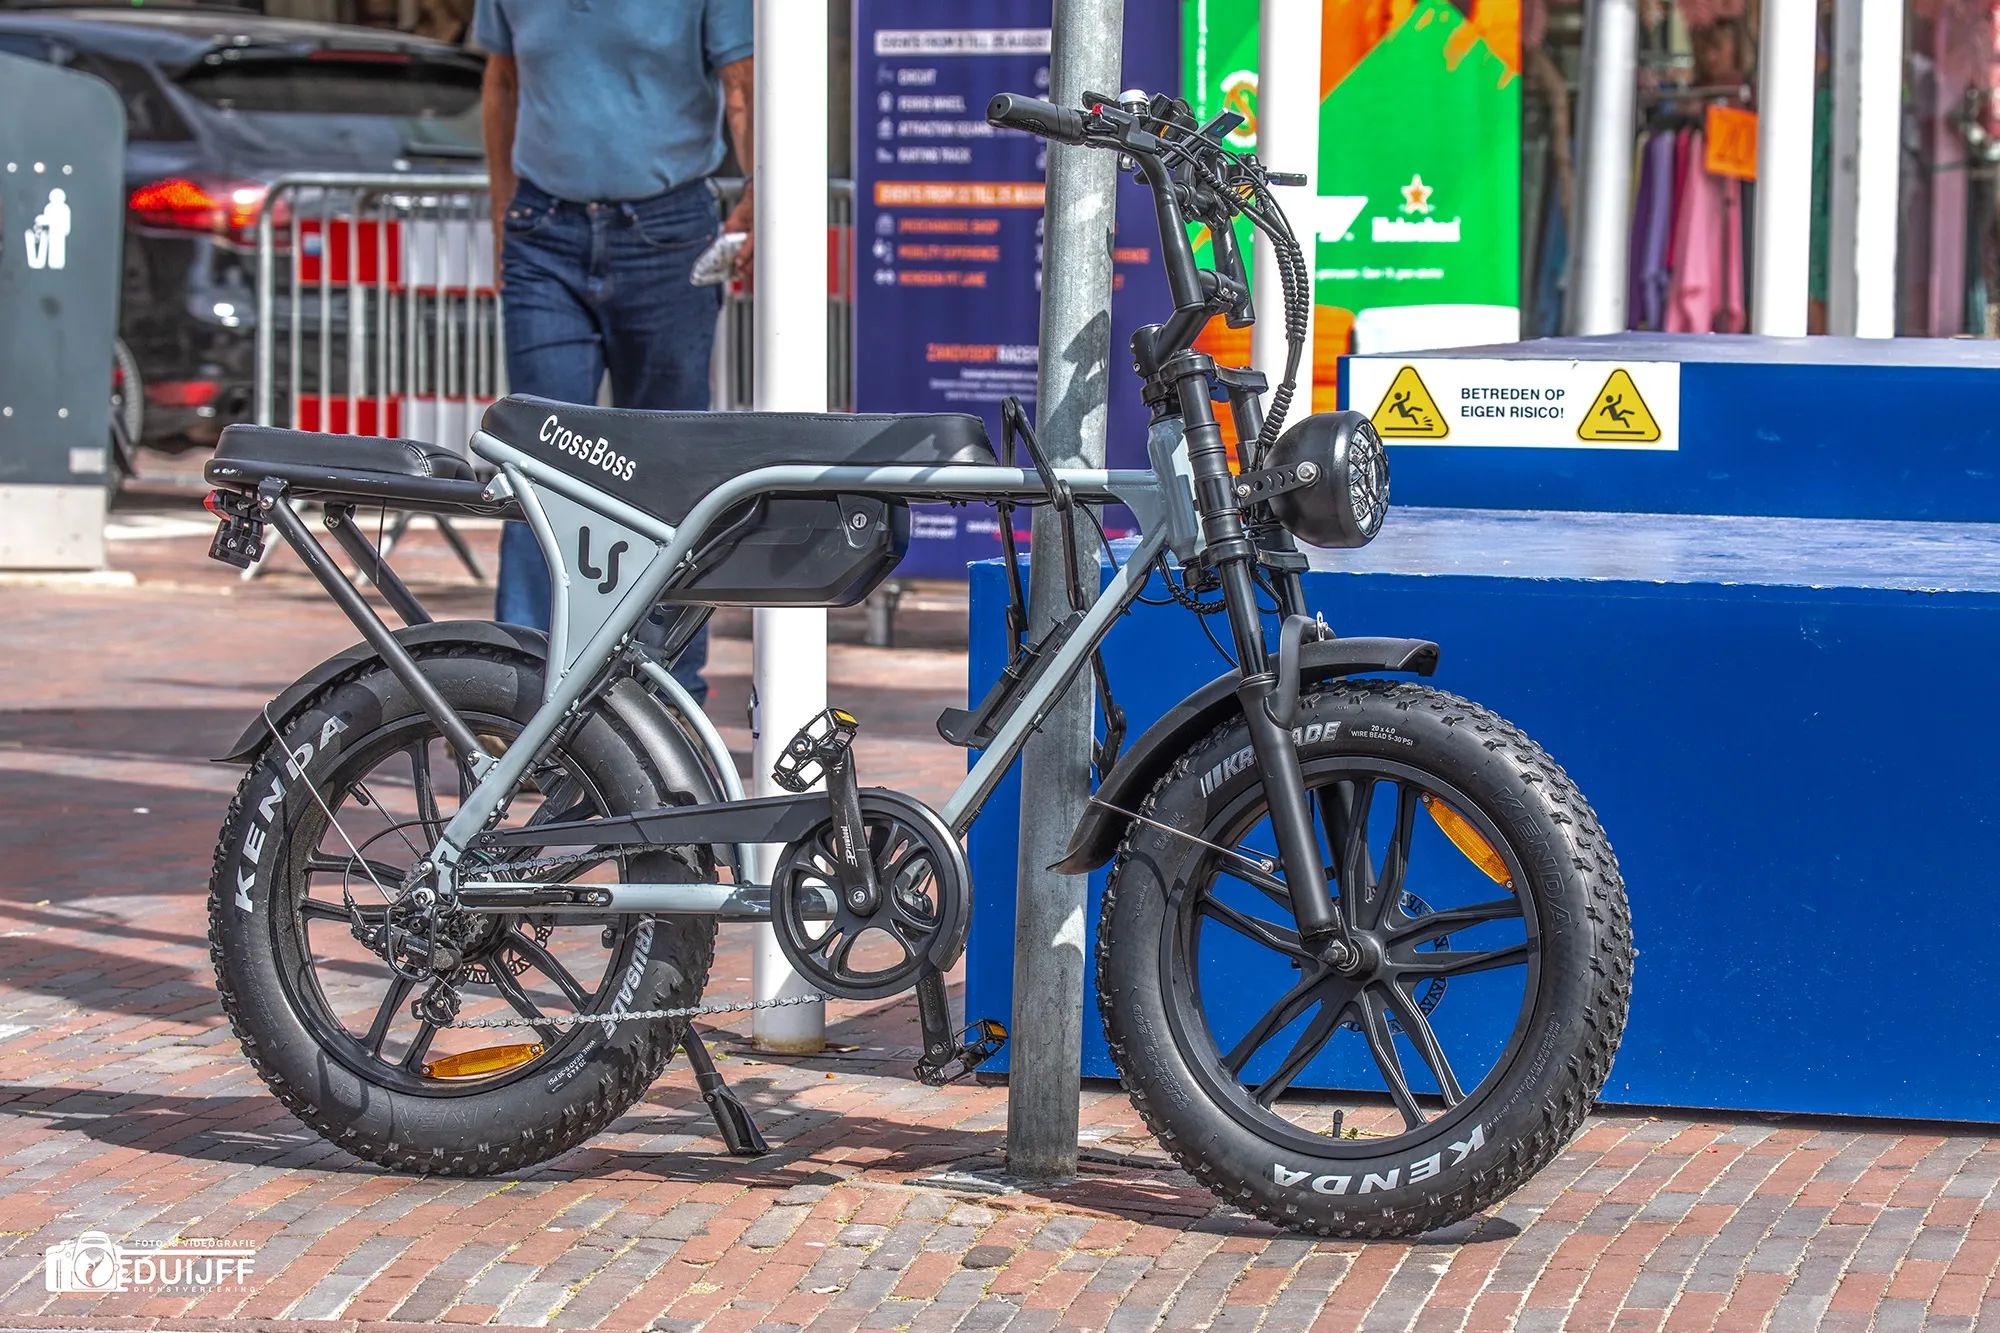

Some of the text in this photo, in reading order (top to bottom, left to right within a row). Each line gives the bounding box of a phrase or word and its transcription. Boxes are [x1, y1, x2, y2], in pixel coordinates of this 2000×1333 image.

[1460, 387, 1565, 400] BETREDEN OP
[1461, 405, 1564, 418] EIGEN RISICO!
[539, 414, 636, 481] CrossBoss
[1371, 724, 1379, 732] 20
[235, 715, 349, 913] KENDA
[1273, 1123, 1486, 1196] KENDA
